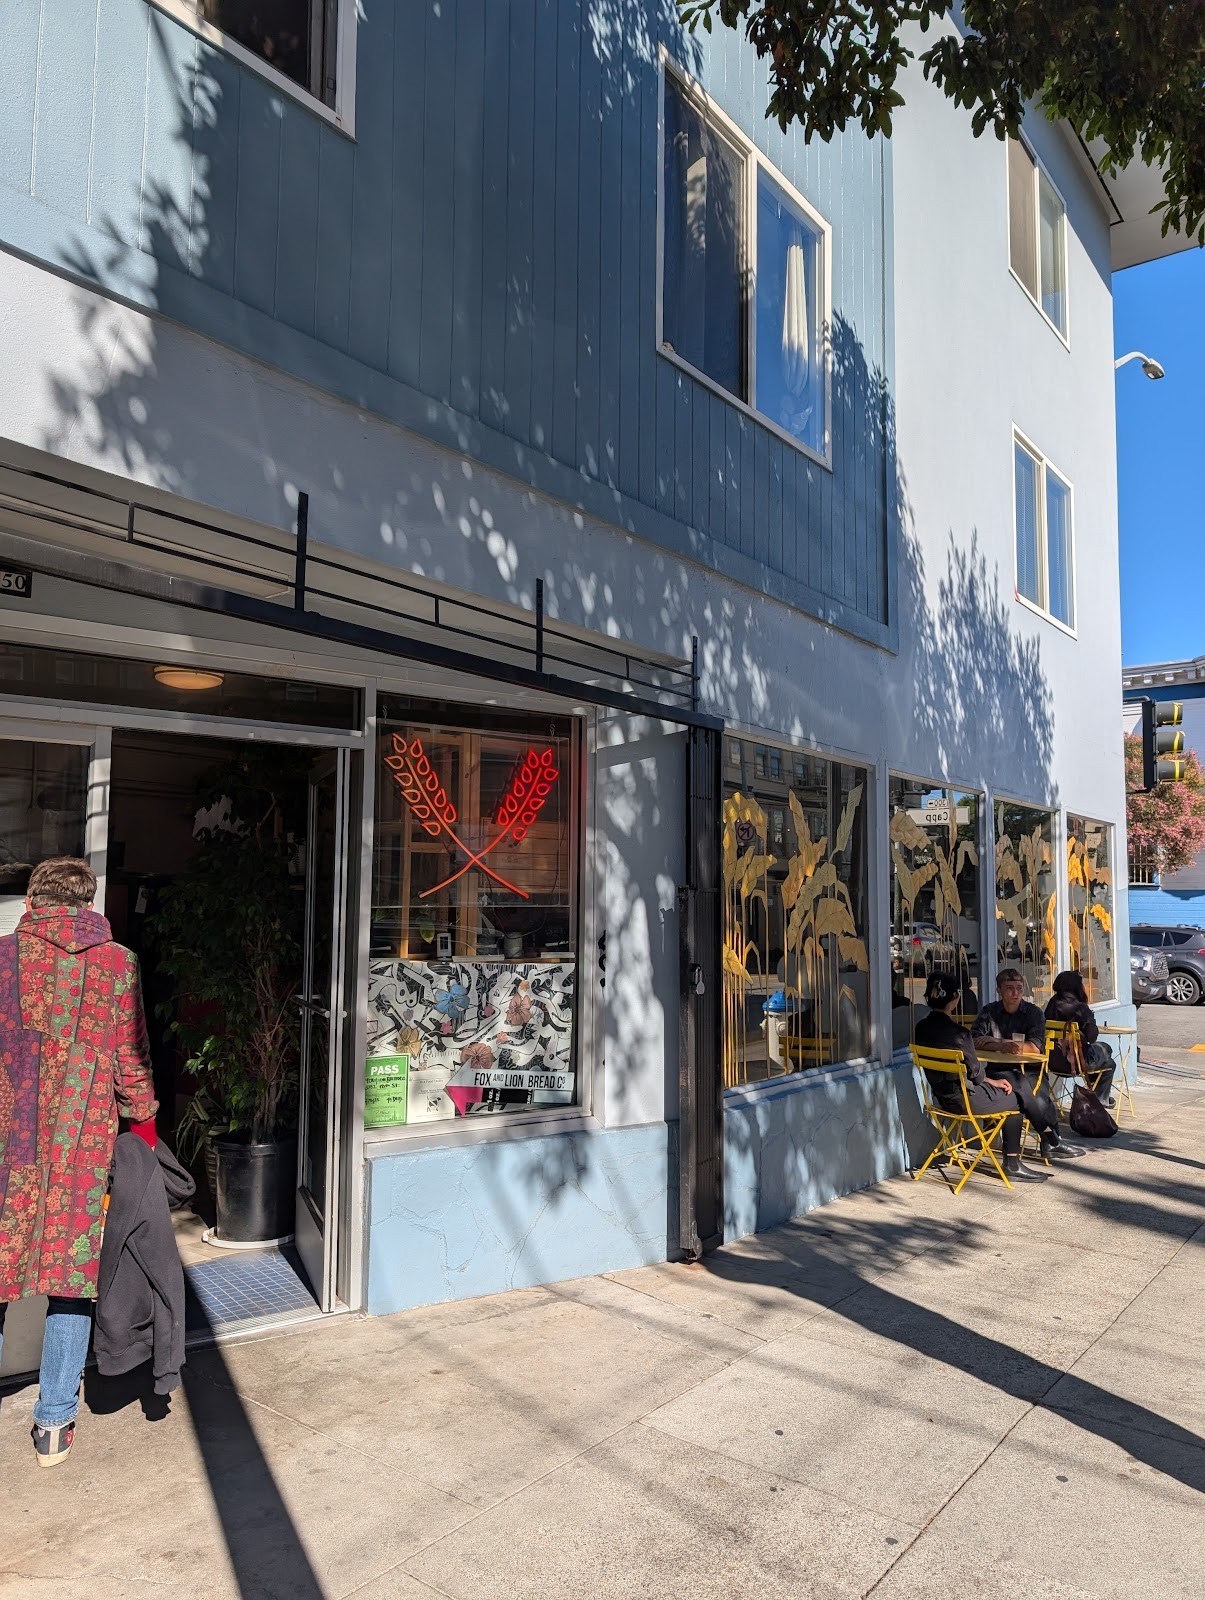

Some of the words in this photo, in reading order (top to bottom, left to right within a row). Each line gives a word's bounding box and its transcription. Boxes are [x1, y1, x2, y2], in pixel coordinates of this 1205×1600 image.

[2, 573, 26, 590] 50
[370, 1064, 399, 1076] PASS
[474, 1072, 491, 1086] FOX
[493, 1073, 504, 1081] AND
[505, 1074, 524, 1087] LION
[528, 1075, 556, 1088] BREAD
